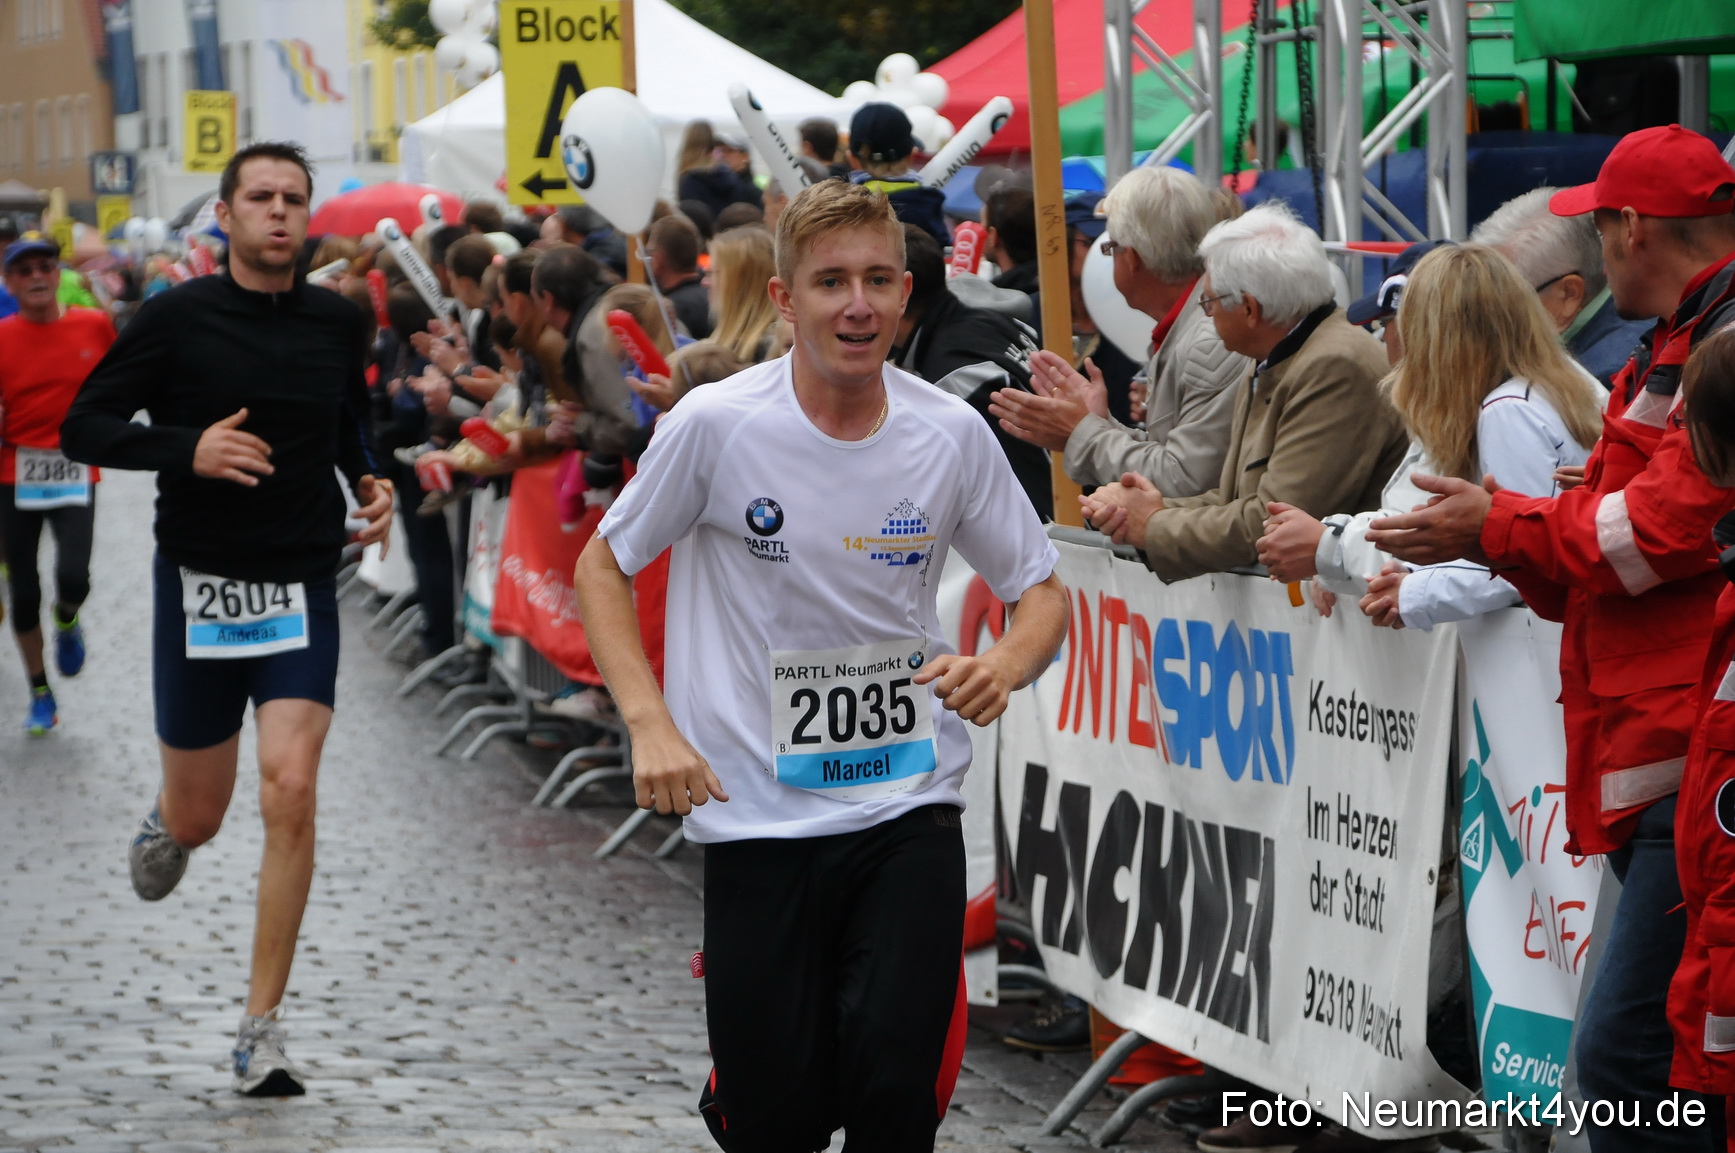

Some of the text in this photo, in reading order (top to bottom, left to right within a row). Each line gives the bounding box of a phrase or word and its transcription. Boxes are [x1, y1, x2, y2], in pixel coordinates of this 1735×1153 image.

[515, 6, 620, 42] Block
[534, 61, 588, 158] A
[198, 117, 221, 153] B
[24, 459, 80, 481] 2386
[749, 498, 781, 512] BMW
[744, 536, 790, 554] PARTL
[843, 536, 868, 551] 14.
[864, 535, 911, 544] Neumarkter
[197, 580, 292, 619] 2604
[216, 626, 277, 643] Andreas
[774, 657, 902, 680] PARTL Neumarkt
[790, 677, 916, 745] 2035
[1308, 678, 1420, 762] Kastengass
[779, 743, 786, 753] B
[822, 753, 890, 783] Marcel
[1307, 785, 1330, 842] Im
[1309, 860, 1386, 933] der Stadt
[1303, 966, 1356, 1034] 92318
[1492, 1041, 1566, 1090] Service
